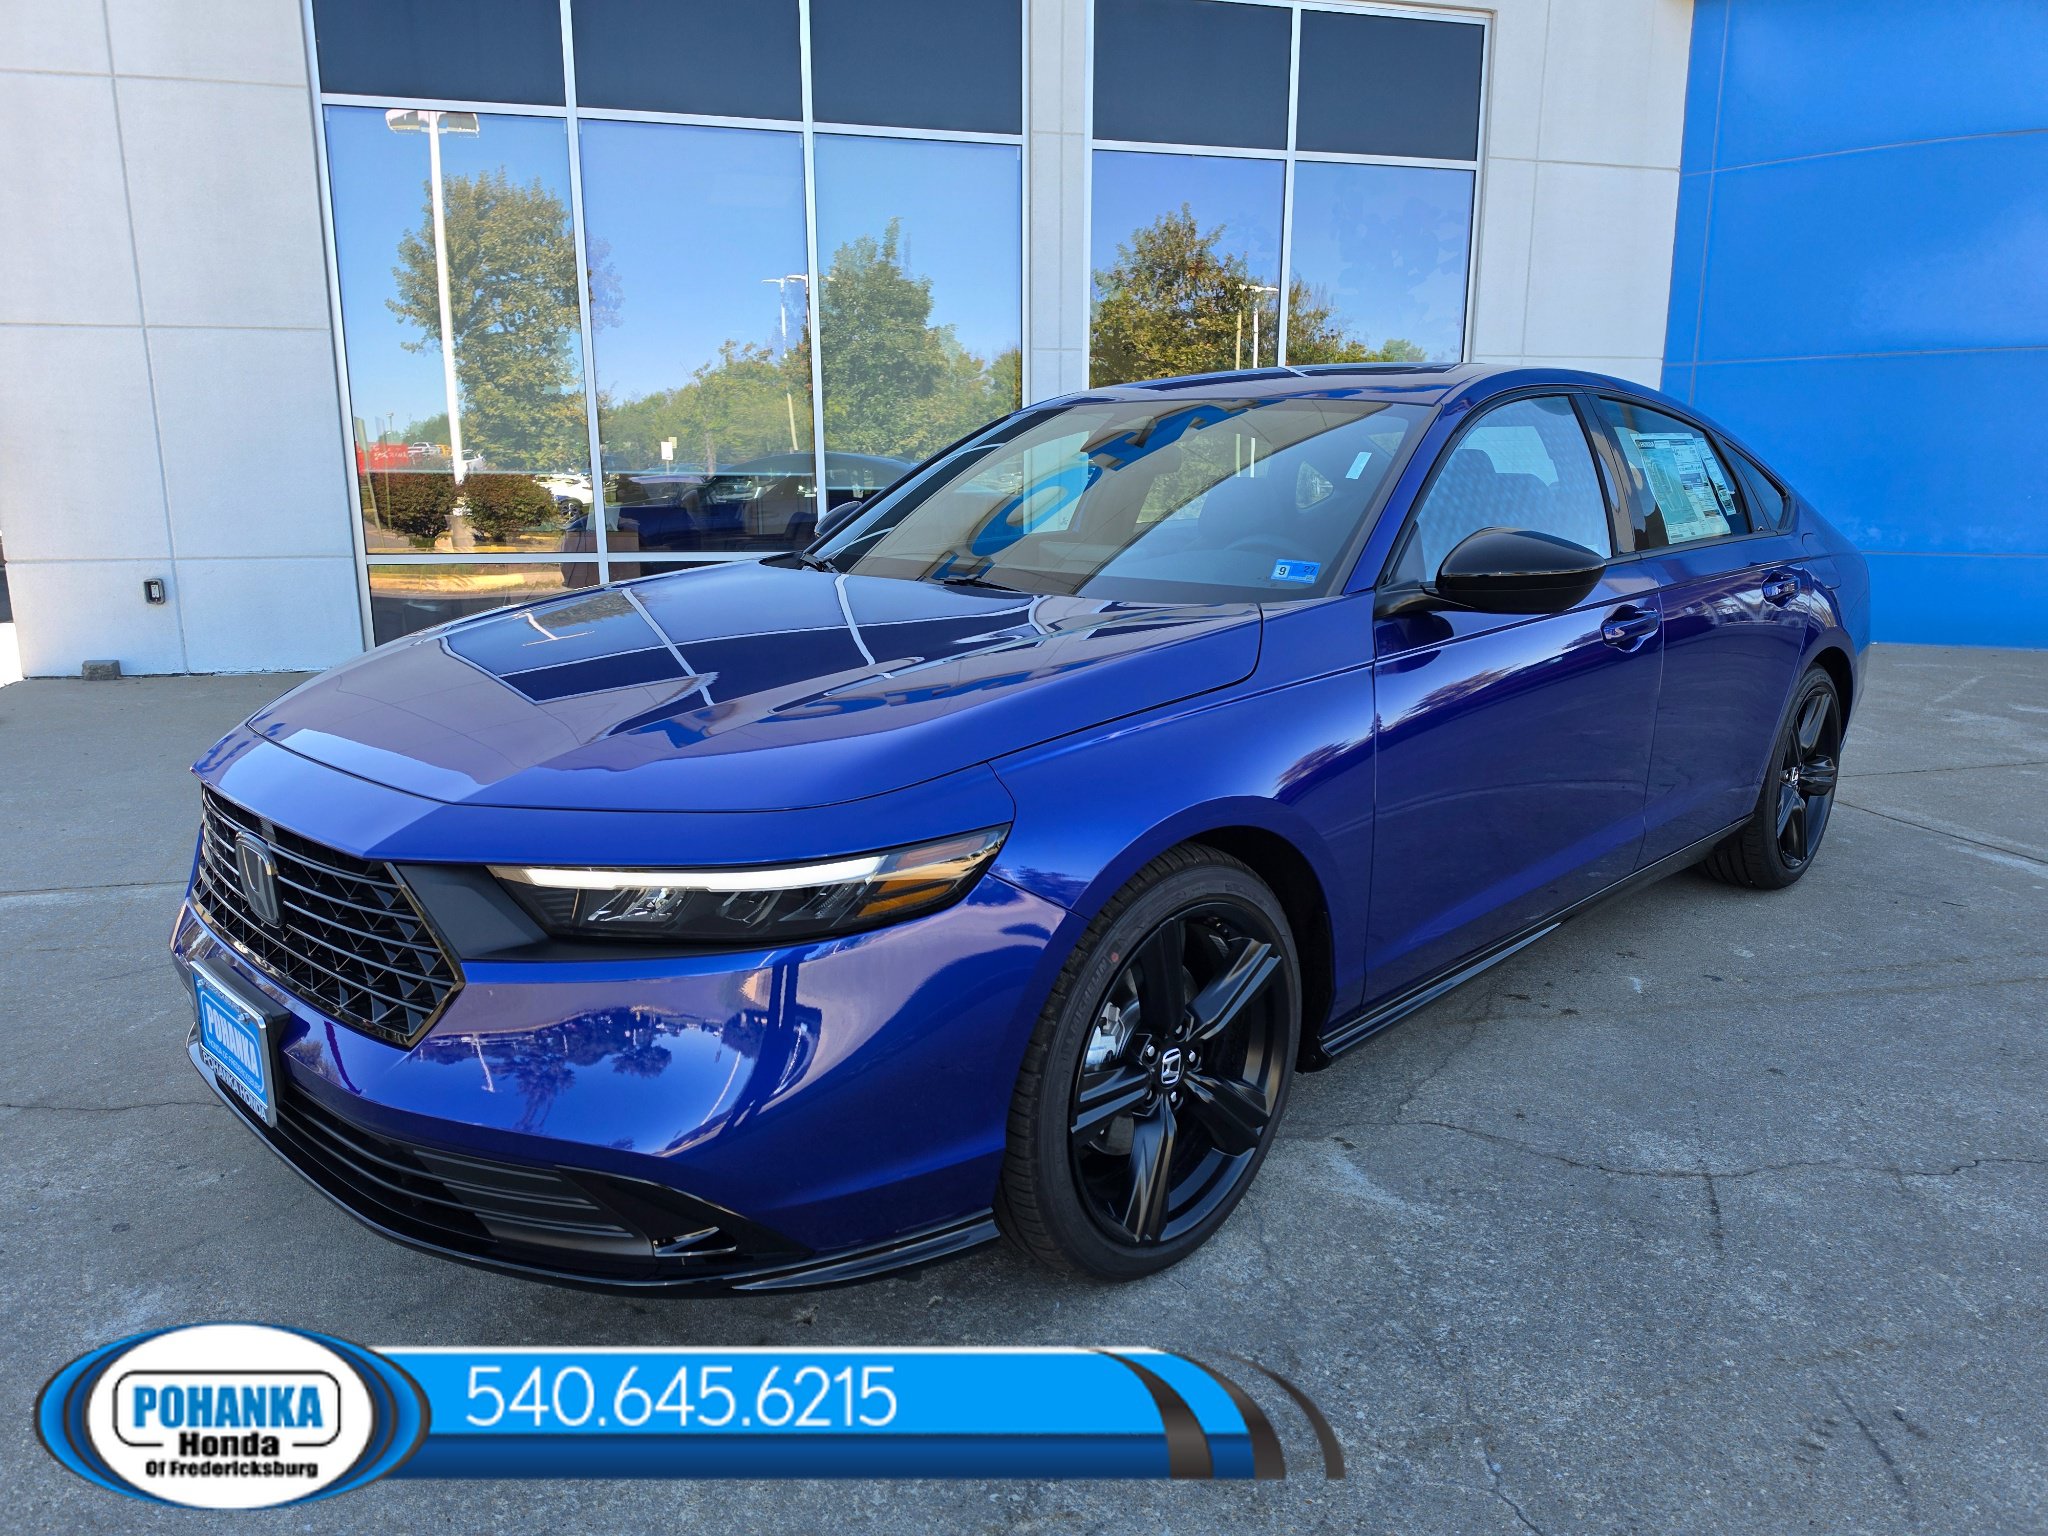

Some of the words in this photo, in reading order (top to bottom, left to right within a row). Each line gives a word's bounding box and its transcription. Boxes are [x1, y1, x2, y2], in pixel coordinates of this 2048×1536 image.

[1279, 567, 1286, 575] 9
[205, 1001, 259, 1077] POHANKA
[202, 1052, 239, 1095] POHANKA
[239, 1087, 267, 1122] HONDA
